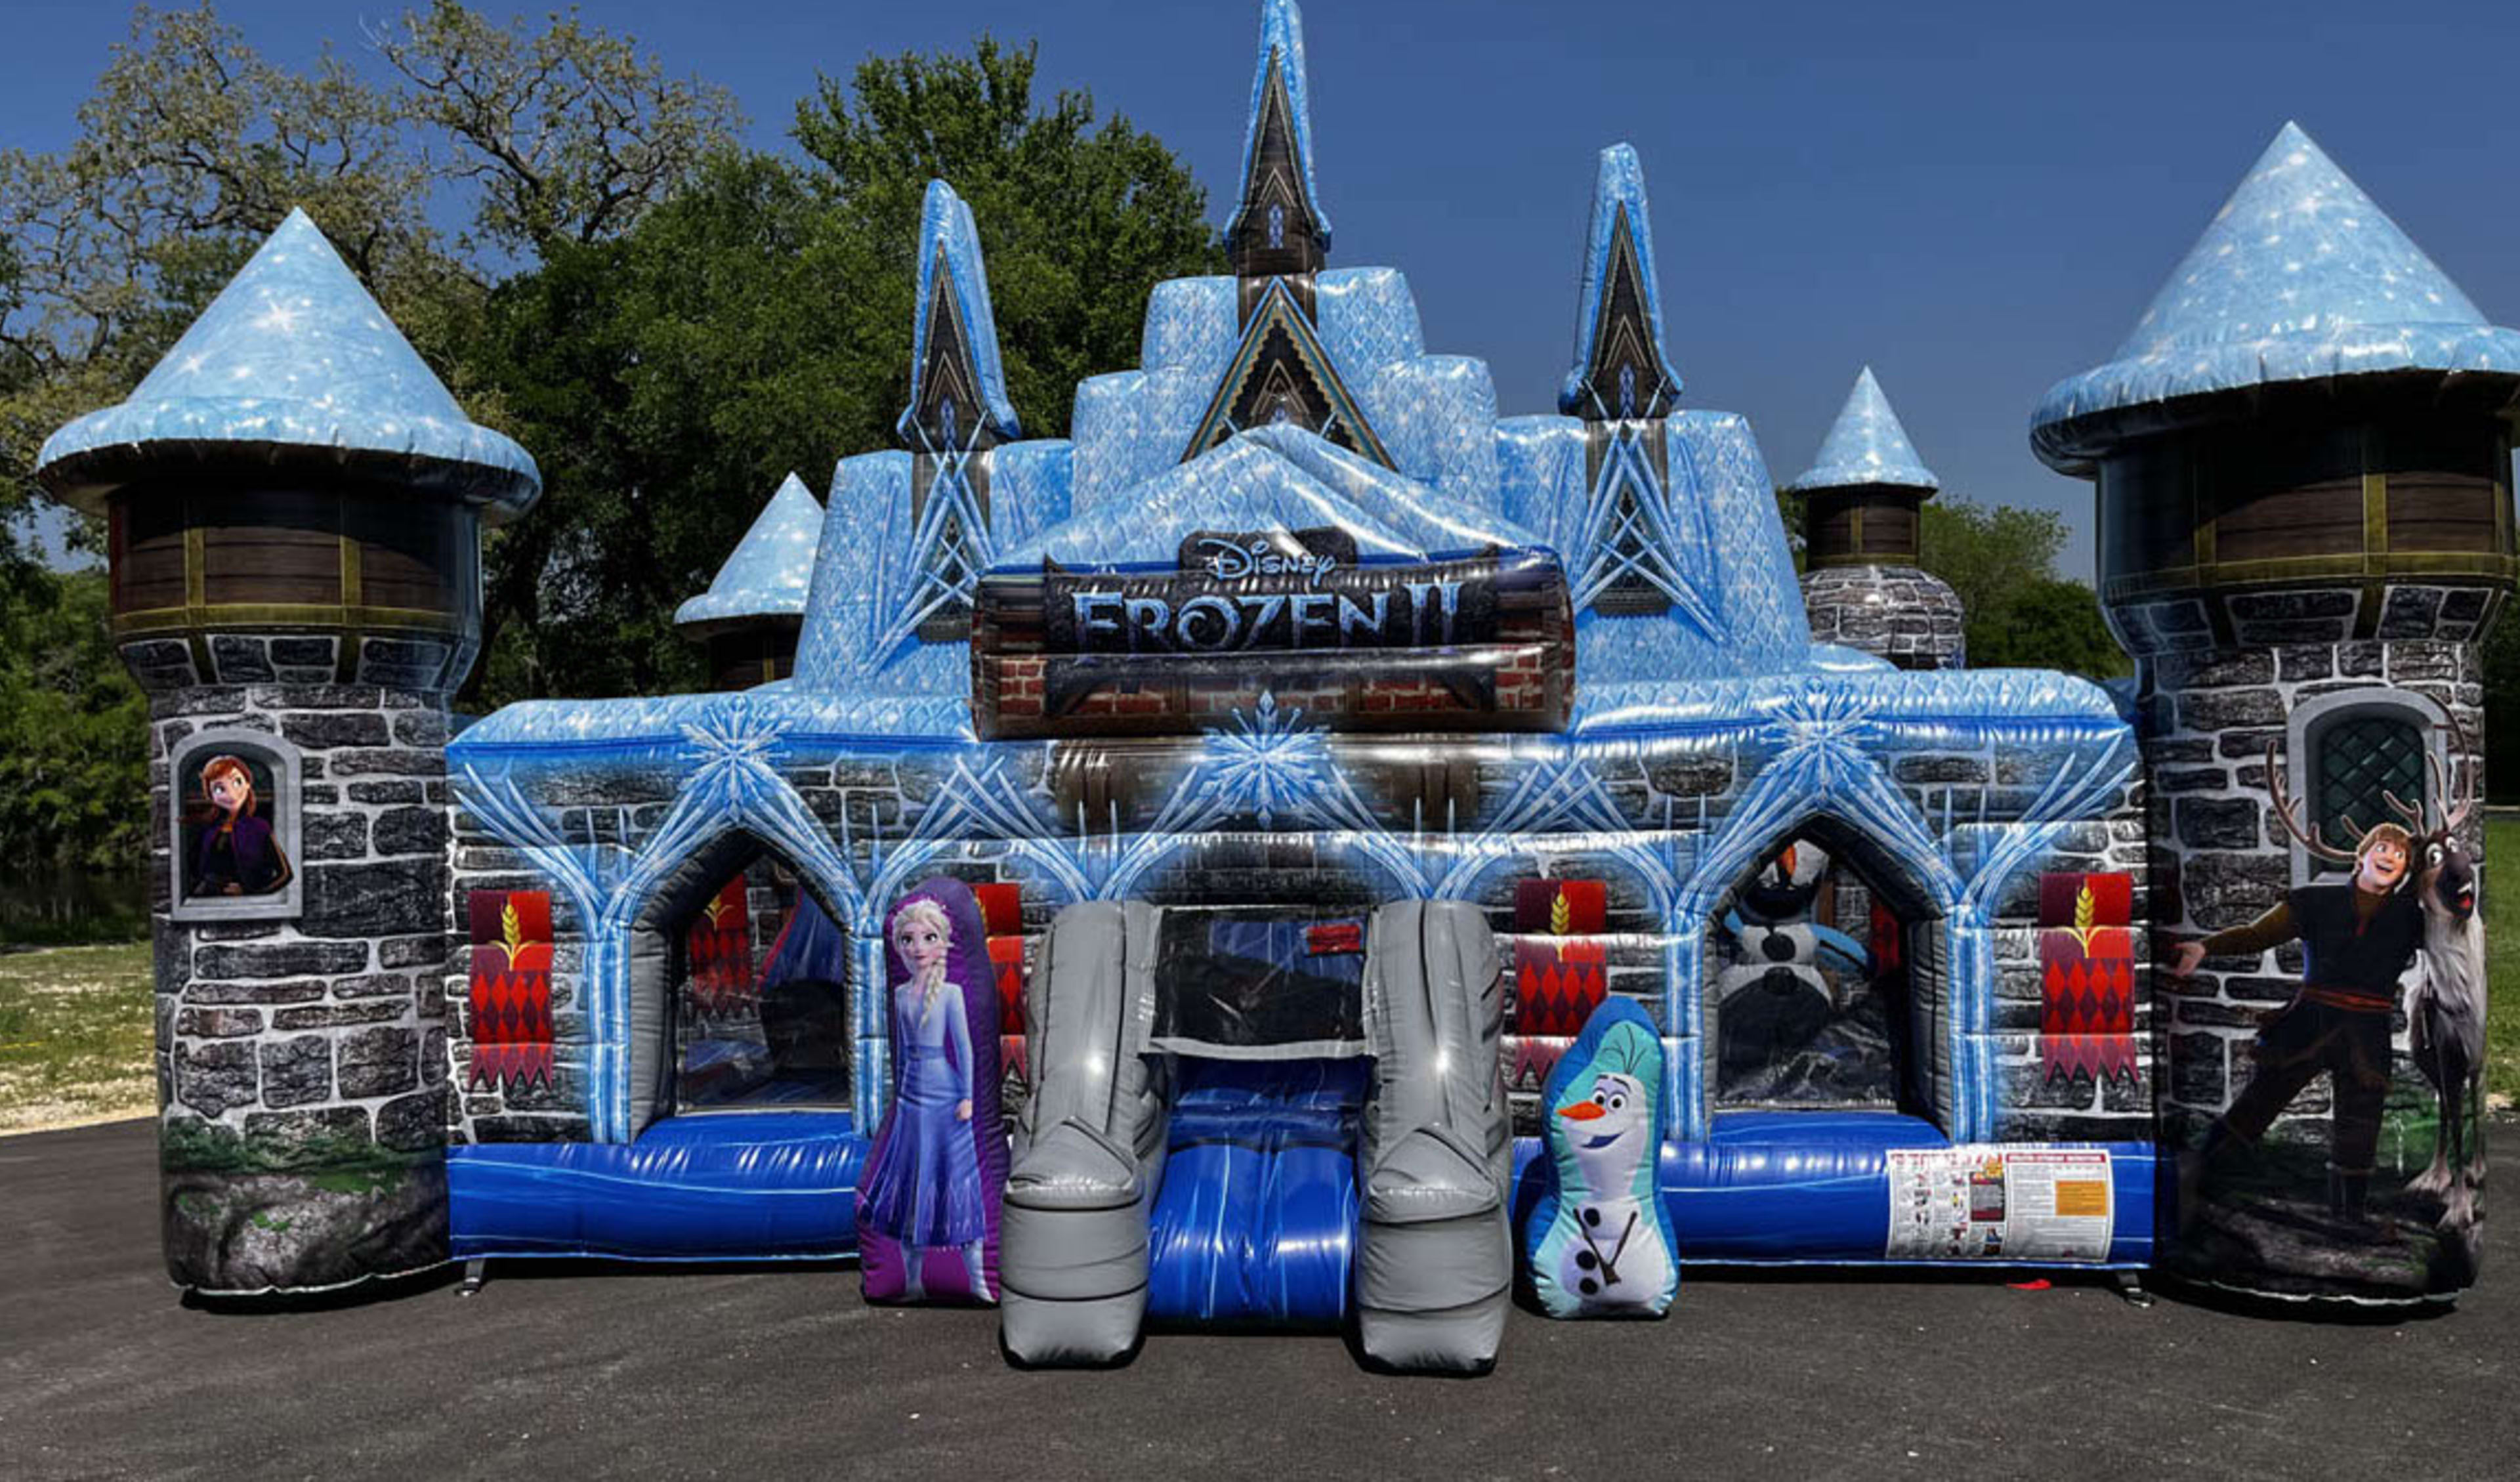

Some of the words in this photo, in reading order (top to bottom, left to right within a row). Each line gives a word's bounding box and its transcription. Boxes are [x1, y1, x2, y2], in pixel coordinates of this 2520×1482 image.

[1198, 538, 1335, 587] Disney
[1072, 591, 1390, 662] FROZEN
[1402, 582, 1463, 654] II
